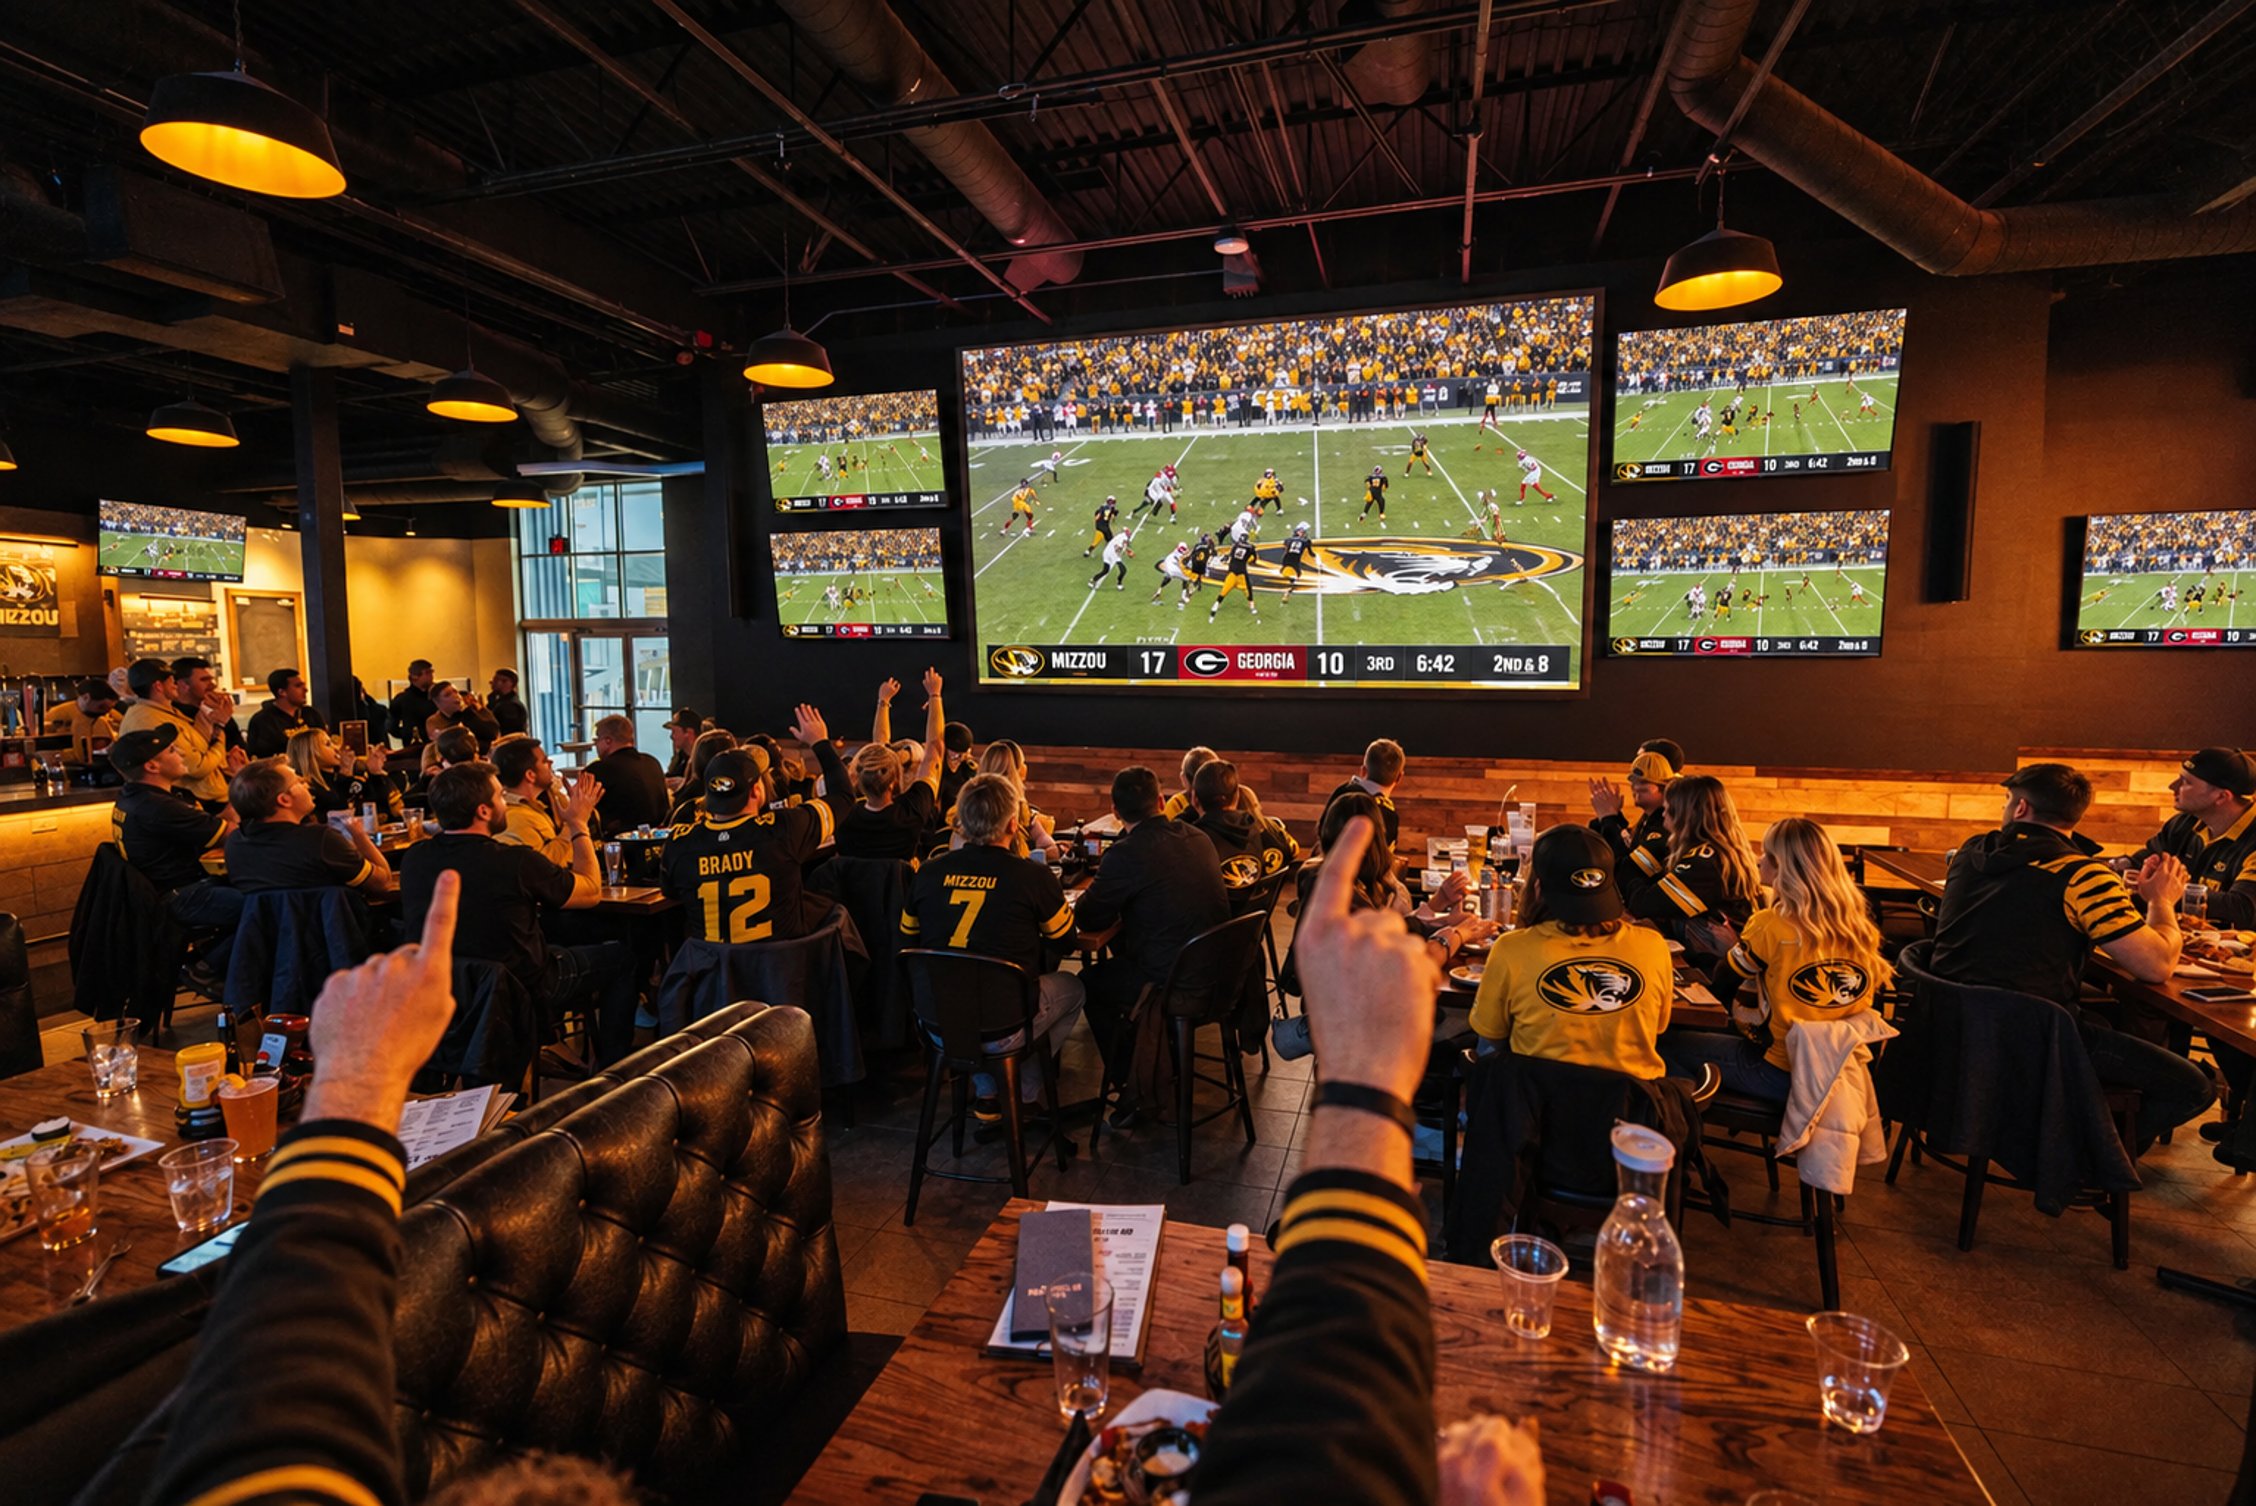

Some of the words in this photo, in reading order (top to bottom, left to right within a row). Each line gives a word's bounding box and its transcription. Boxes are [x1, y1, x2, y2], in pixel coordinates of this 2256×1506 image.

[1764, 458, 1777, 471] 10
[0, 608, 59, 626] IZZOU
[1052, 652, 1107, 669] MIZZOU
[1140, 651, 1166, 674] 17
[1192, 651, 1230, 673] G
[1238, 652, 1295, 670] GEORGIA
[1317, 652, 1344, 675] 10
[1366, 656, 1395, 671] 3RD
[1416, 654, 1455, 672] 6:42
[1493, 655, 1522, 672] 2ND
[1524, 656, 1534, 672] &
[1538, 655, 1549, 672] 8
[698, 850, 754, 875] BRADY
[943, 874, 997, 889] MIZZOU
[697, 873, 773, 944] 12
[947, 889, 987, 949] 7
